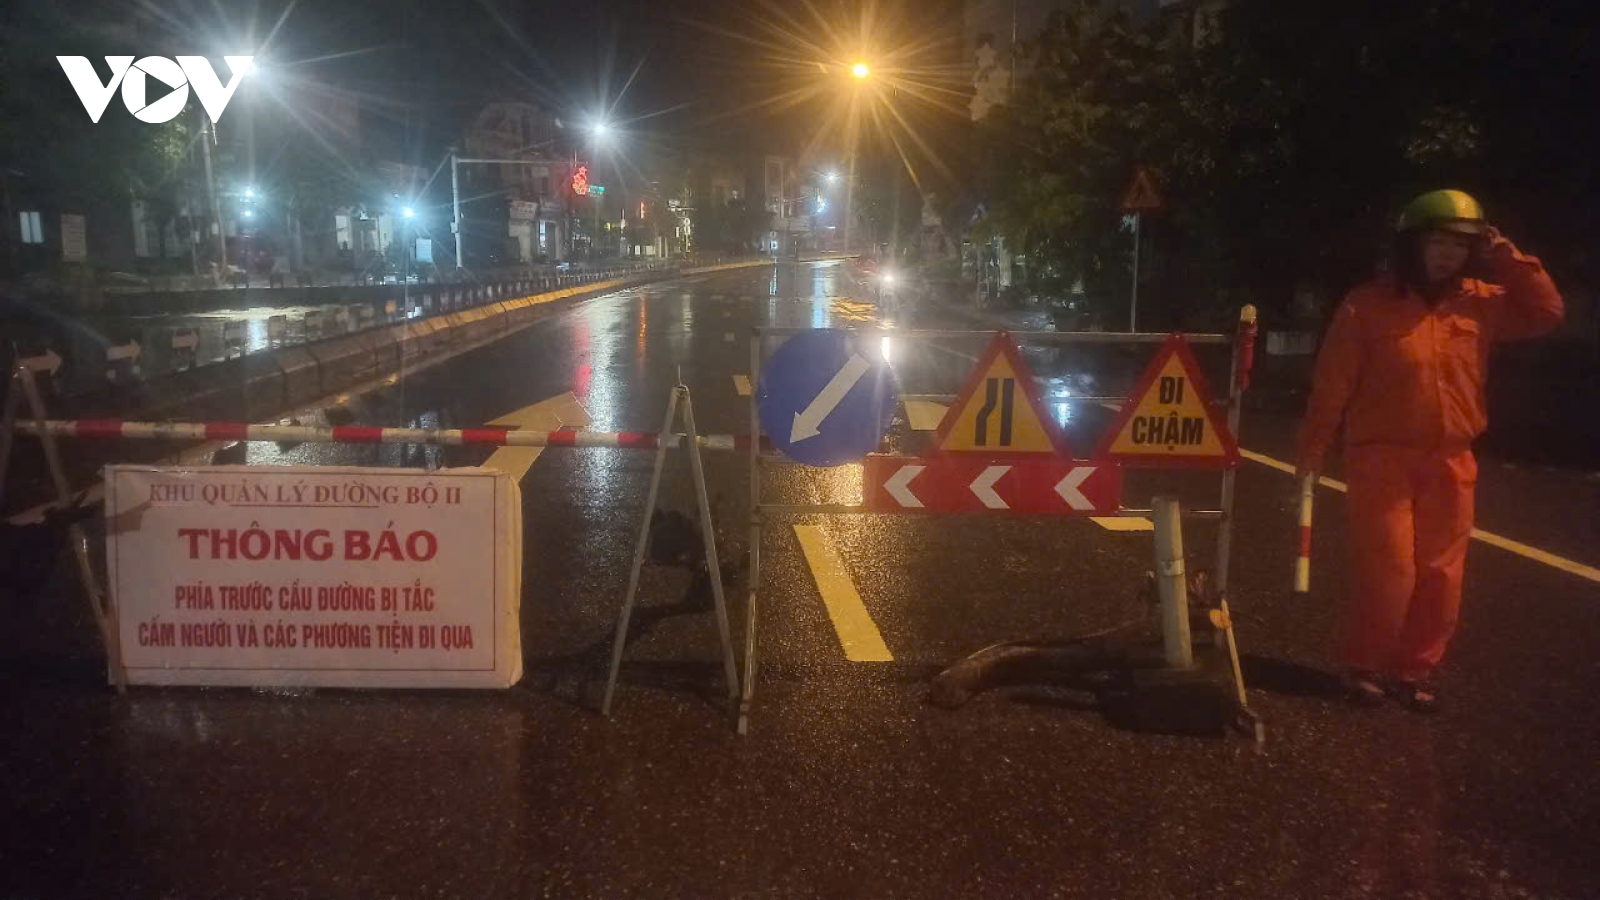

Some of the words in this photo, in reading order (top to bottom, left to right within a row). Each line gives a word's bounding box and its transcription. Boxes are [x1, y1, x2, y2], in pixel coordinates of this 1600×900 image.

[1160, 376, 1185, 404] ĐI
[1132, 411, 1204, 451] CHẬM
[150, 485, 191, 502] KHU
[201, 480, 270, 505] QUẢN
[276, 480, 305, 503] LÝ
[314, 481, 399, 504] ĐƯỜNG
[406, 482, 438, 508] BỘ
[445, 487, 462, 505] II
[178, 521, 334, 561] THÔNG
[344, 521, 437, 561] BÁO
[174, 581, 214, 610] PHÍA
[219, 580, 273, 611] TRƯỚC
[318, 581, 375, 611] ĐƯỜNG
[381, 587, 398, 617] BỊ
[402, 578, 435, 611] TẮC
[138, 614, 176, 647] CẤM
[181, 618, 232, 647] NGƯỜI
[237, 619, 258, 648] VÀ
[264, 619, 298, 648] CÁC
[302, 622, 371, 648] PHƯƠNG
[376, 619, 413, 654] TIỆN
[419, 625, 435, 649] ĐI
[441, 625, 474, 651] QUA
